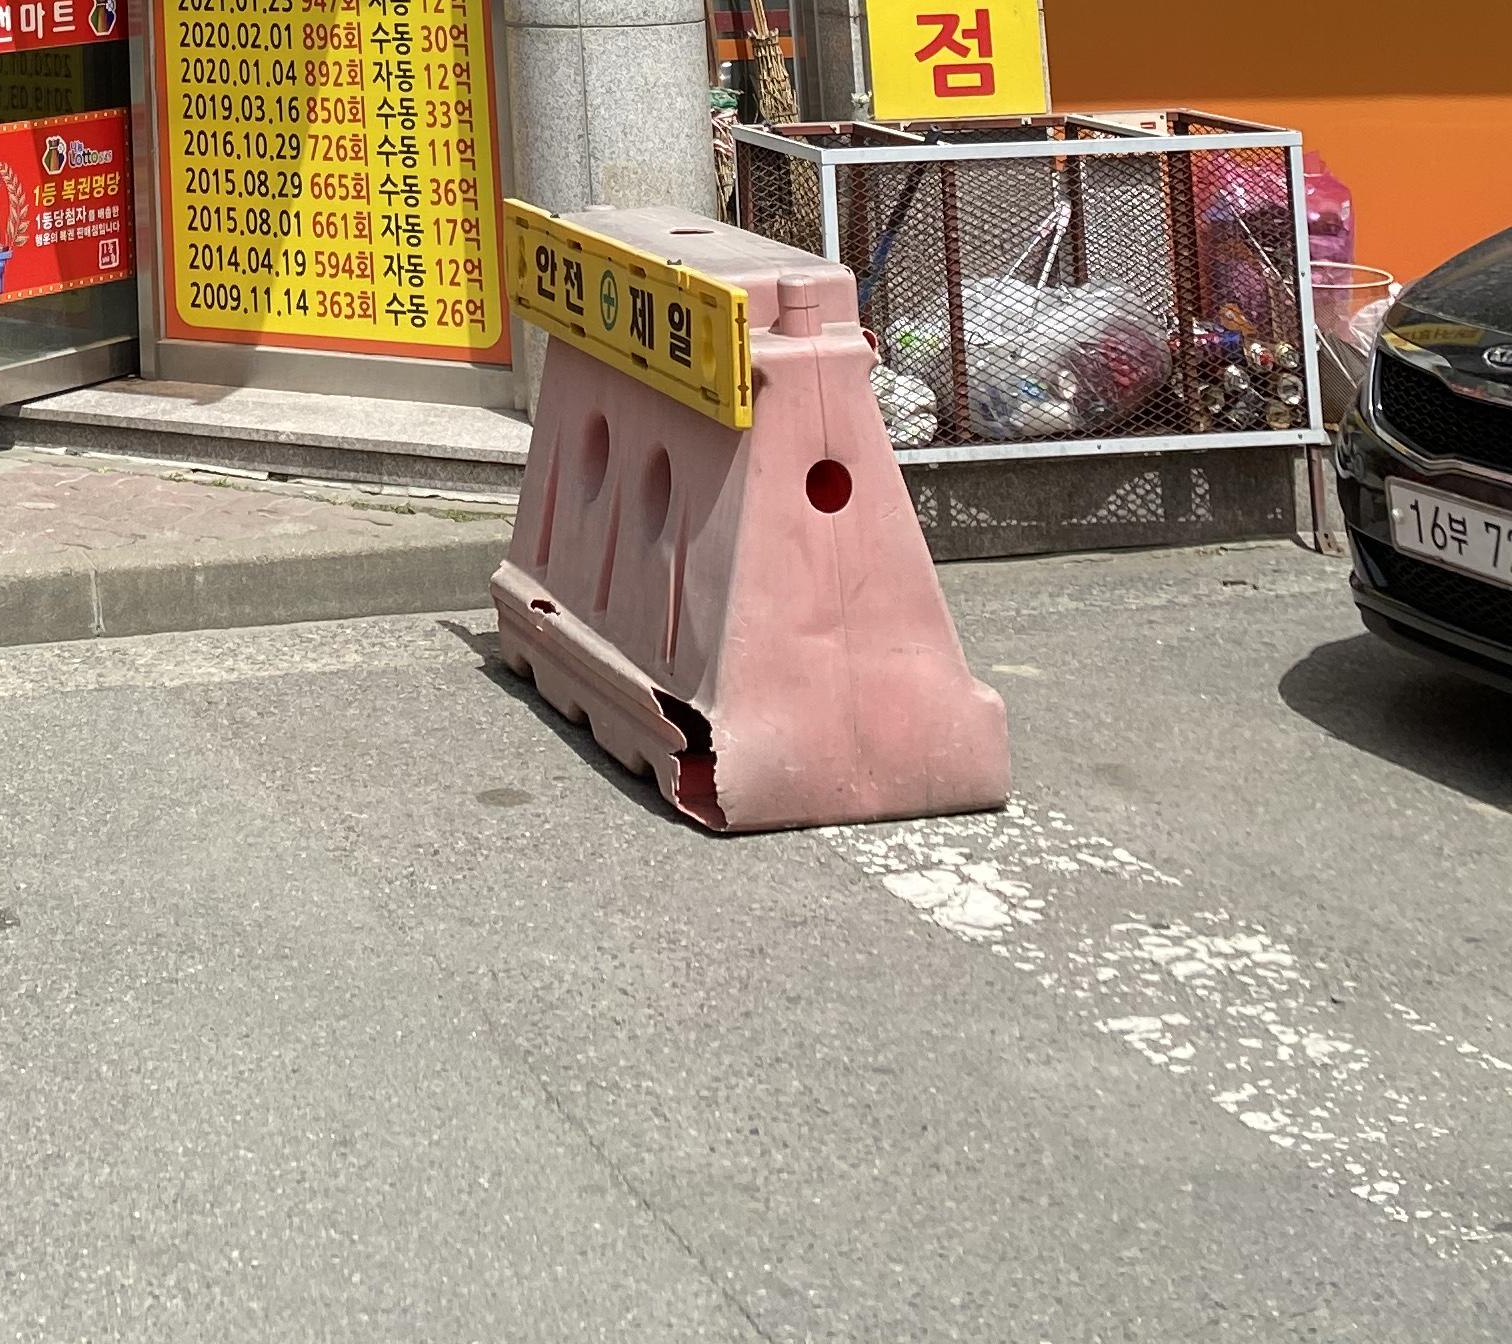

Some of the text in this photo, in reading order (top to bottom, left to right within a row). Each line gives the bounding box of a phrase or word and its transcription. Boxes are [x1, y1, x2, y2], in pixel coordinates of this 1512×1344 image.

[179, 21, 470, 57] 2020.02.01 896회 수동 30억
[180, 57, 472, 94] 2020.01.04 892회 자동 12억
[182, 93, 474, 133] 2019.03.16 850회 수동 33억
[183, 129, 477, 171] 2016.10.29 726회 수동 11억
[32, 171, 121, 208] 1등 복권명당
[185, 167, 479, 211] 2015.08.29 665회 수동 36억
[186, 204, 482, 251] 2015.08.01 661회 자동 17억
[188, 243, 485, 292] 2014.04.19 594회 자동 12억
[190, 281, 486, 332] 2009.11.14 363회 수동 26억
[535, 244, 691, 369] 안전 제일
